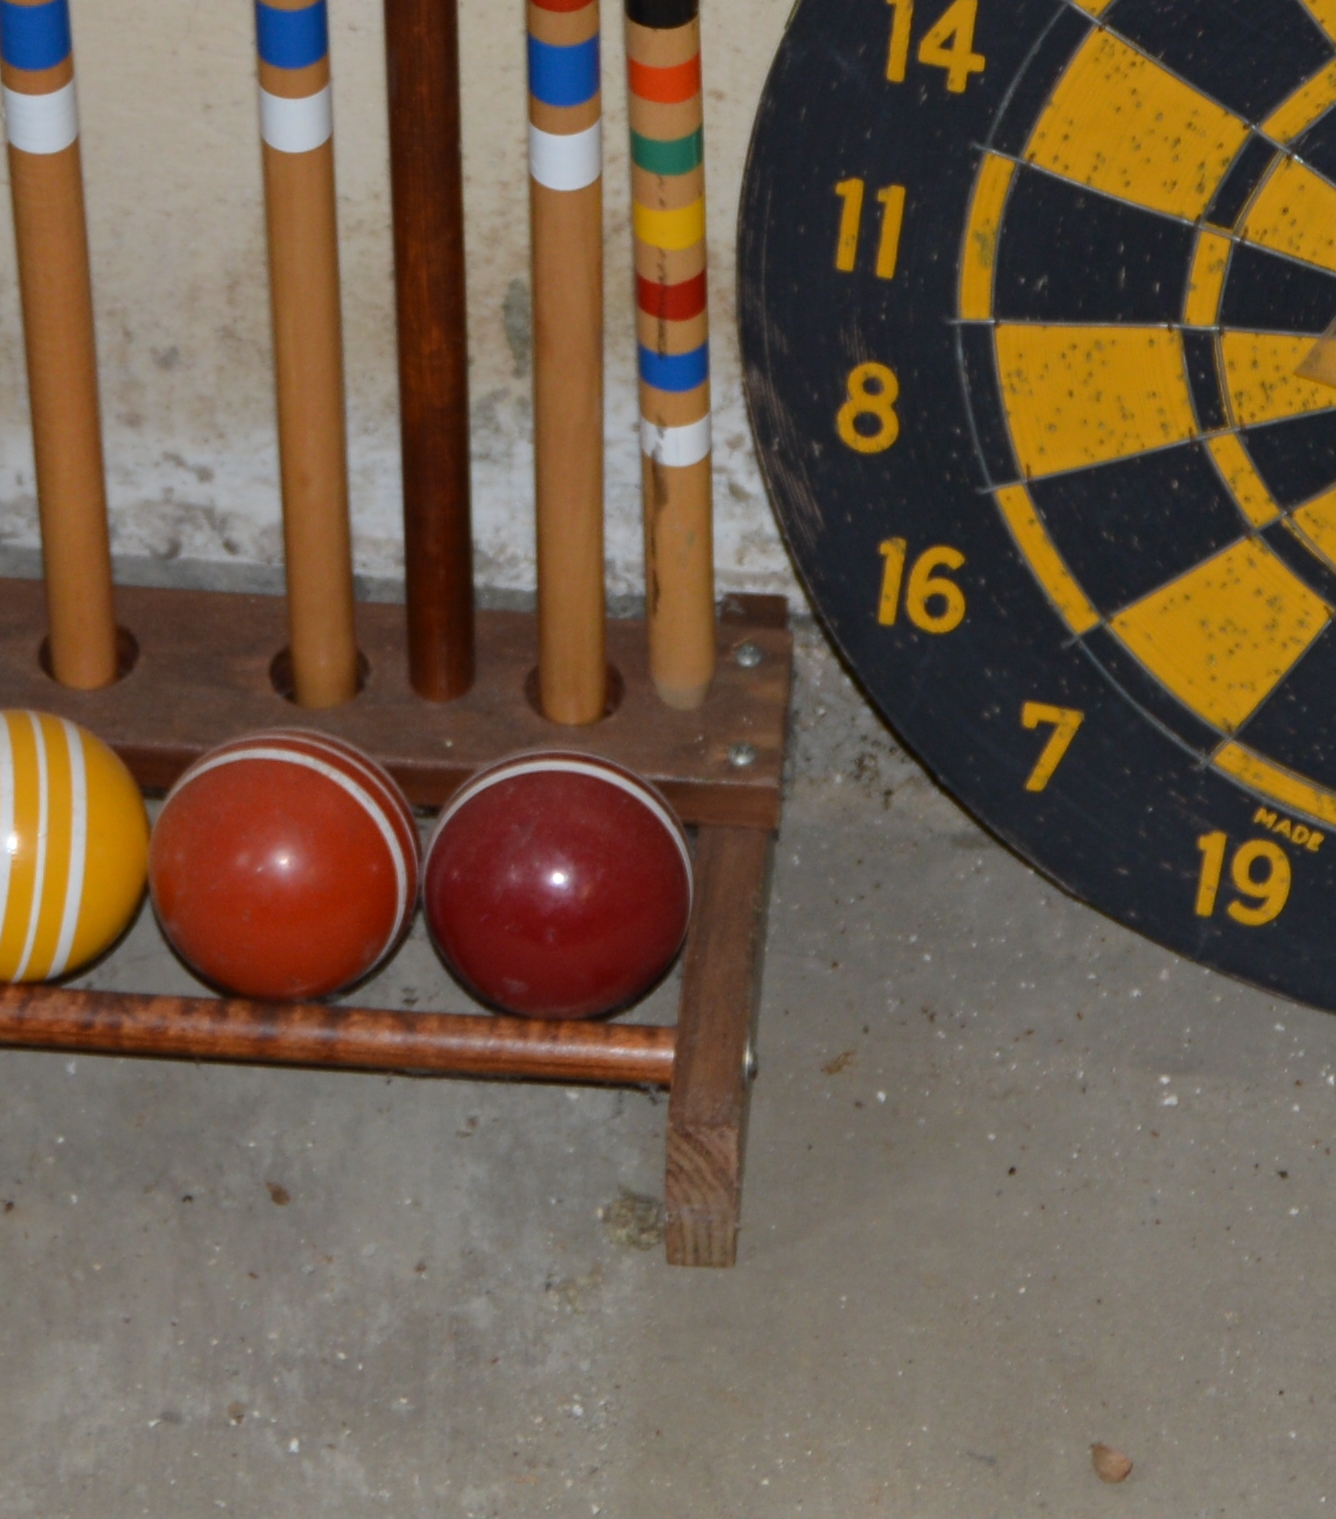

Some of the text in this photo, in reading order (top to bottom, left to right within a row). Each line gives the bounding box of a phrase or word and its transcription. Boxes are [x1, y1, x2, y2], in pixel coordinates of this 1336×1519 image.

[835, 177, 906, 280] 11
[836, 361, 900, 454] 8
[878, 537, 966, 634] 16
[1021, 701, 1084, 792] 7
[1252, 807, 1325, 852] MADE
[1195, 830, 1291, 927] 19
